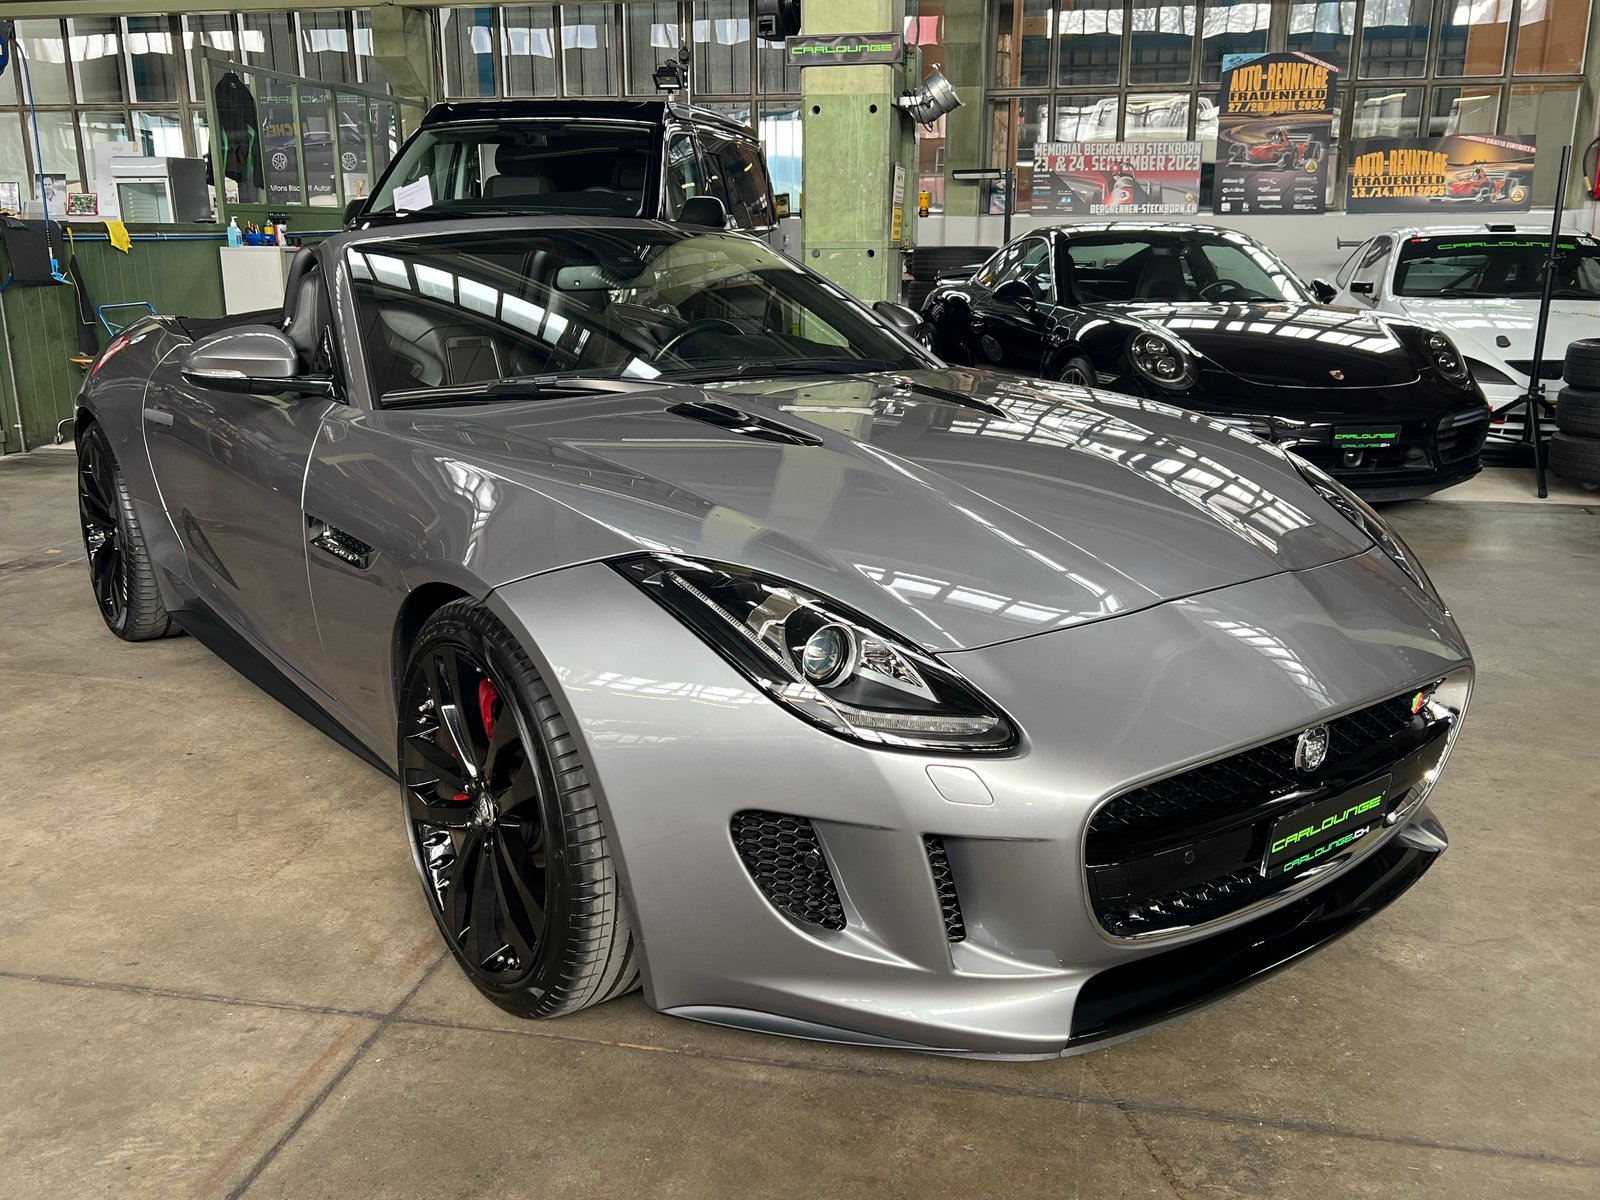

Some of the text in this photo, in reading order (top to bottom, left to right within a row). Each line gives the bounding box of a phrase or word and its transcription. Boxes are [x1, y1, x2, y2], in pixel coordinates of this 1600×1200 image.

[791, 44, 892, 54] CARLOUNGE
[1230, 62, 1329, 91] AUTO-RENNTAGE
[1230, 90, 1327, 101] FRAUENFELD
[1298, 100, 1326, 111] 2024
[1034, 142, 1201, 156] MEMORIAL BERGRENNEN STECKBORN
[1033, 156, 1053, 172] 23.
[1056, 156, 1066, 172] &
[1068, 156, 1089, 172] 24.
[1166, 155, 1200, 171] 2023
[1354, 149, 1448, 177] AUTO-RENNTAGE
[1354, 175, 1446, 186] FRAUENFELD
[1416, 185, 1445, 197] 2023
[1089, 203, 1198, 214] BERGRENNEN-STECKBORN.CH
[1271, 795, 1382, 853] CARLOUNGE
[1283, 825, 1370, 872] CARLOUNGE.CH
